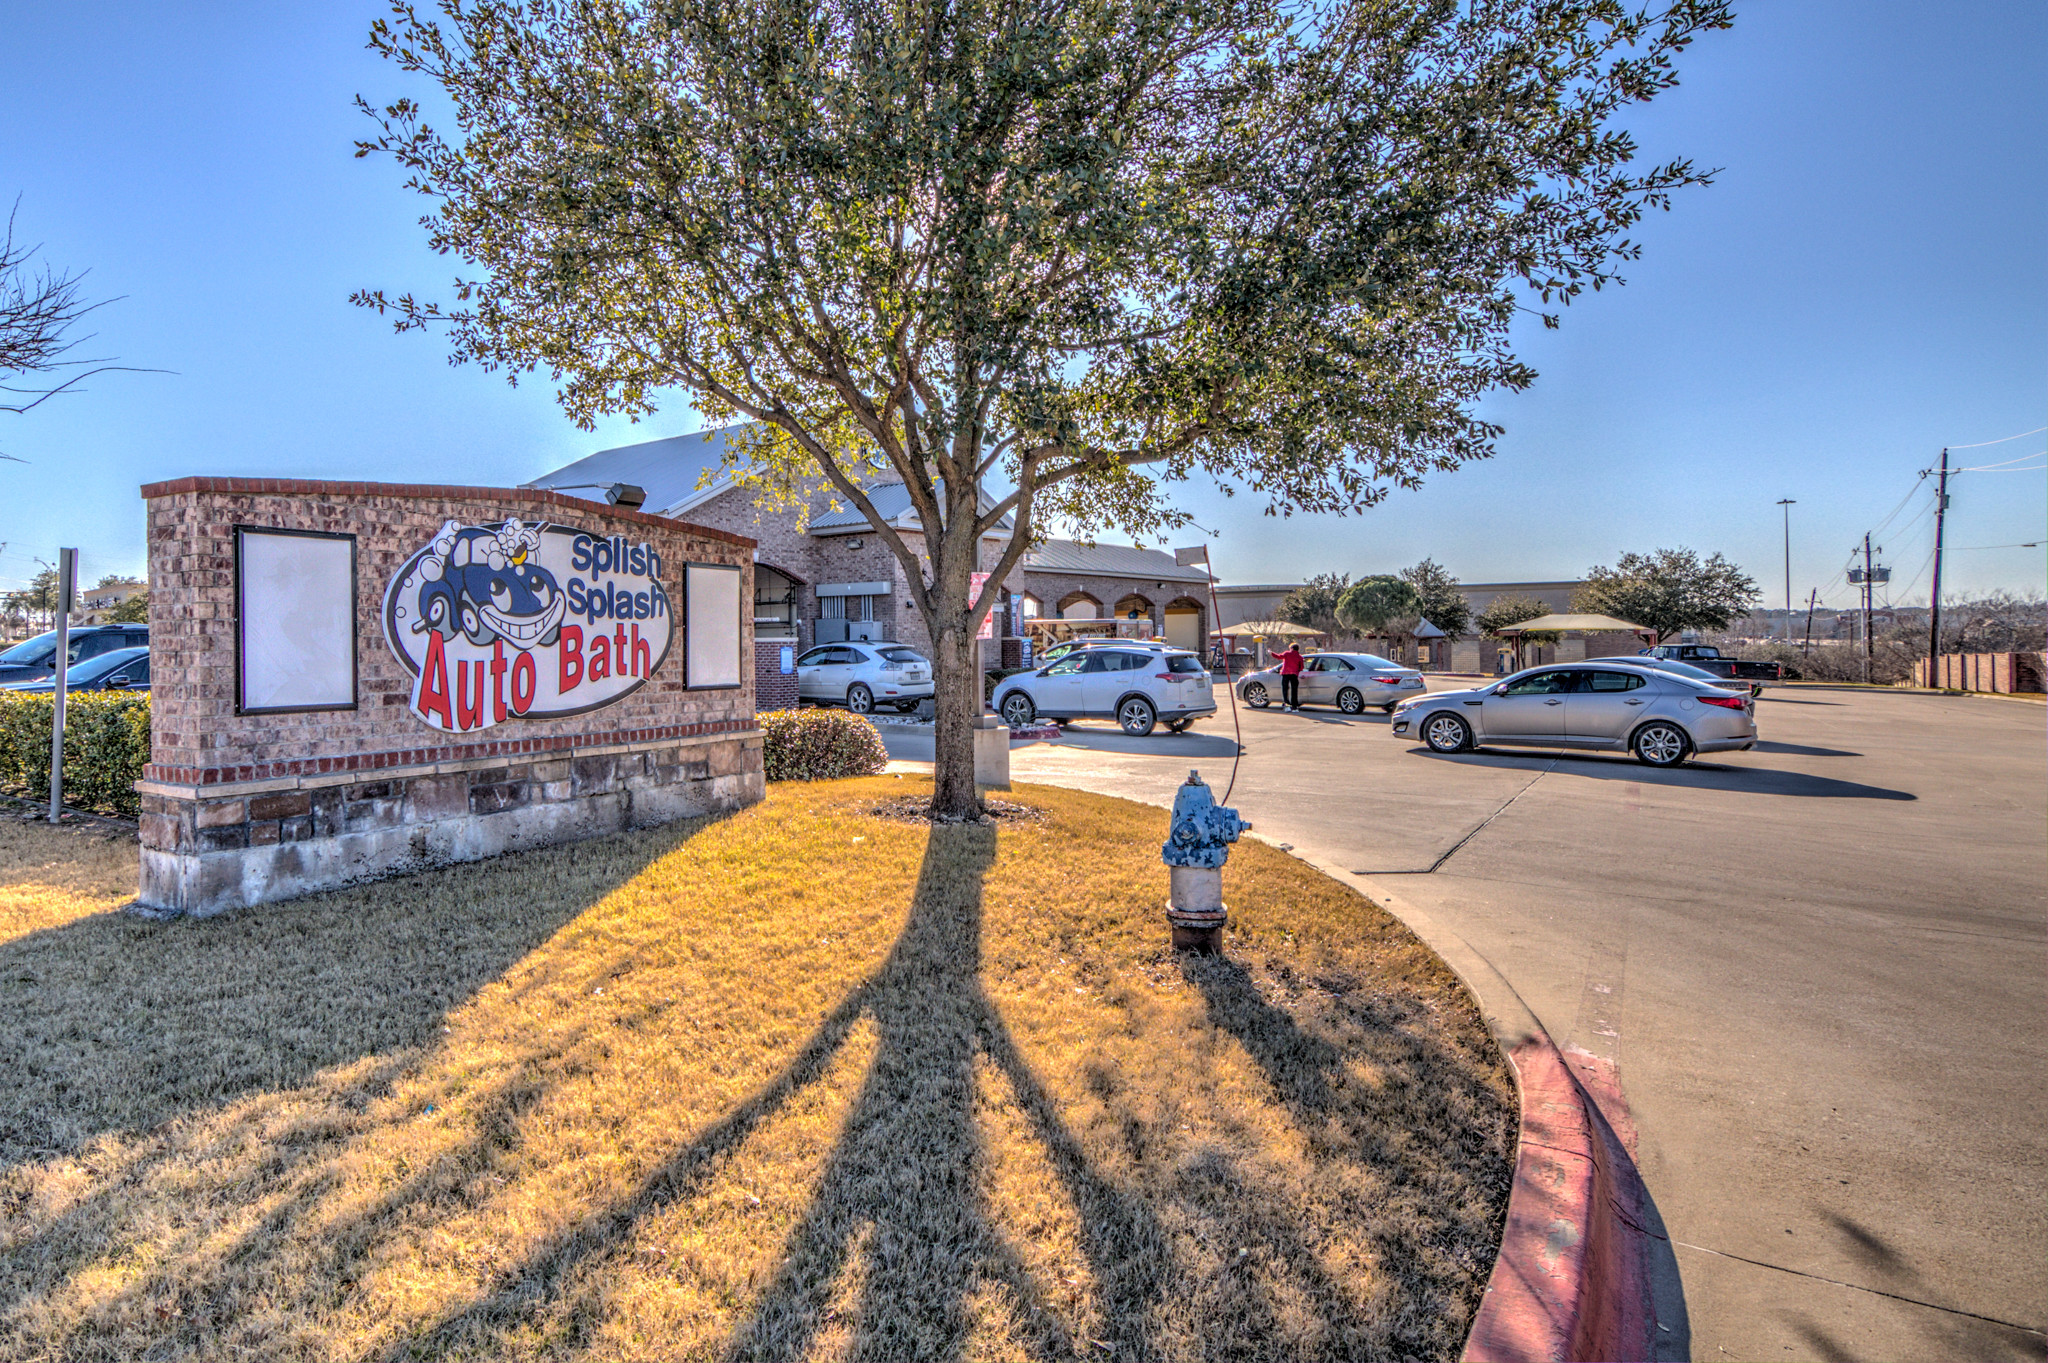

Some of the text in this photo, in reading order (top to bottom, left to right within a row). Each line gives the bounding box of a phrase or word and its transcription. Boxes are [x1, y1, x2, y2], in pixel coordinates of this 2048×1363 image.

[571, 535, 662, 581] Splish
[567, 578, 665, 625] Splash
[417, 623, 651, 731] Auto Bath
